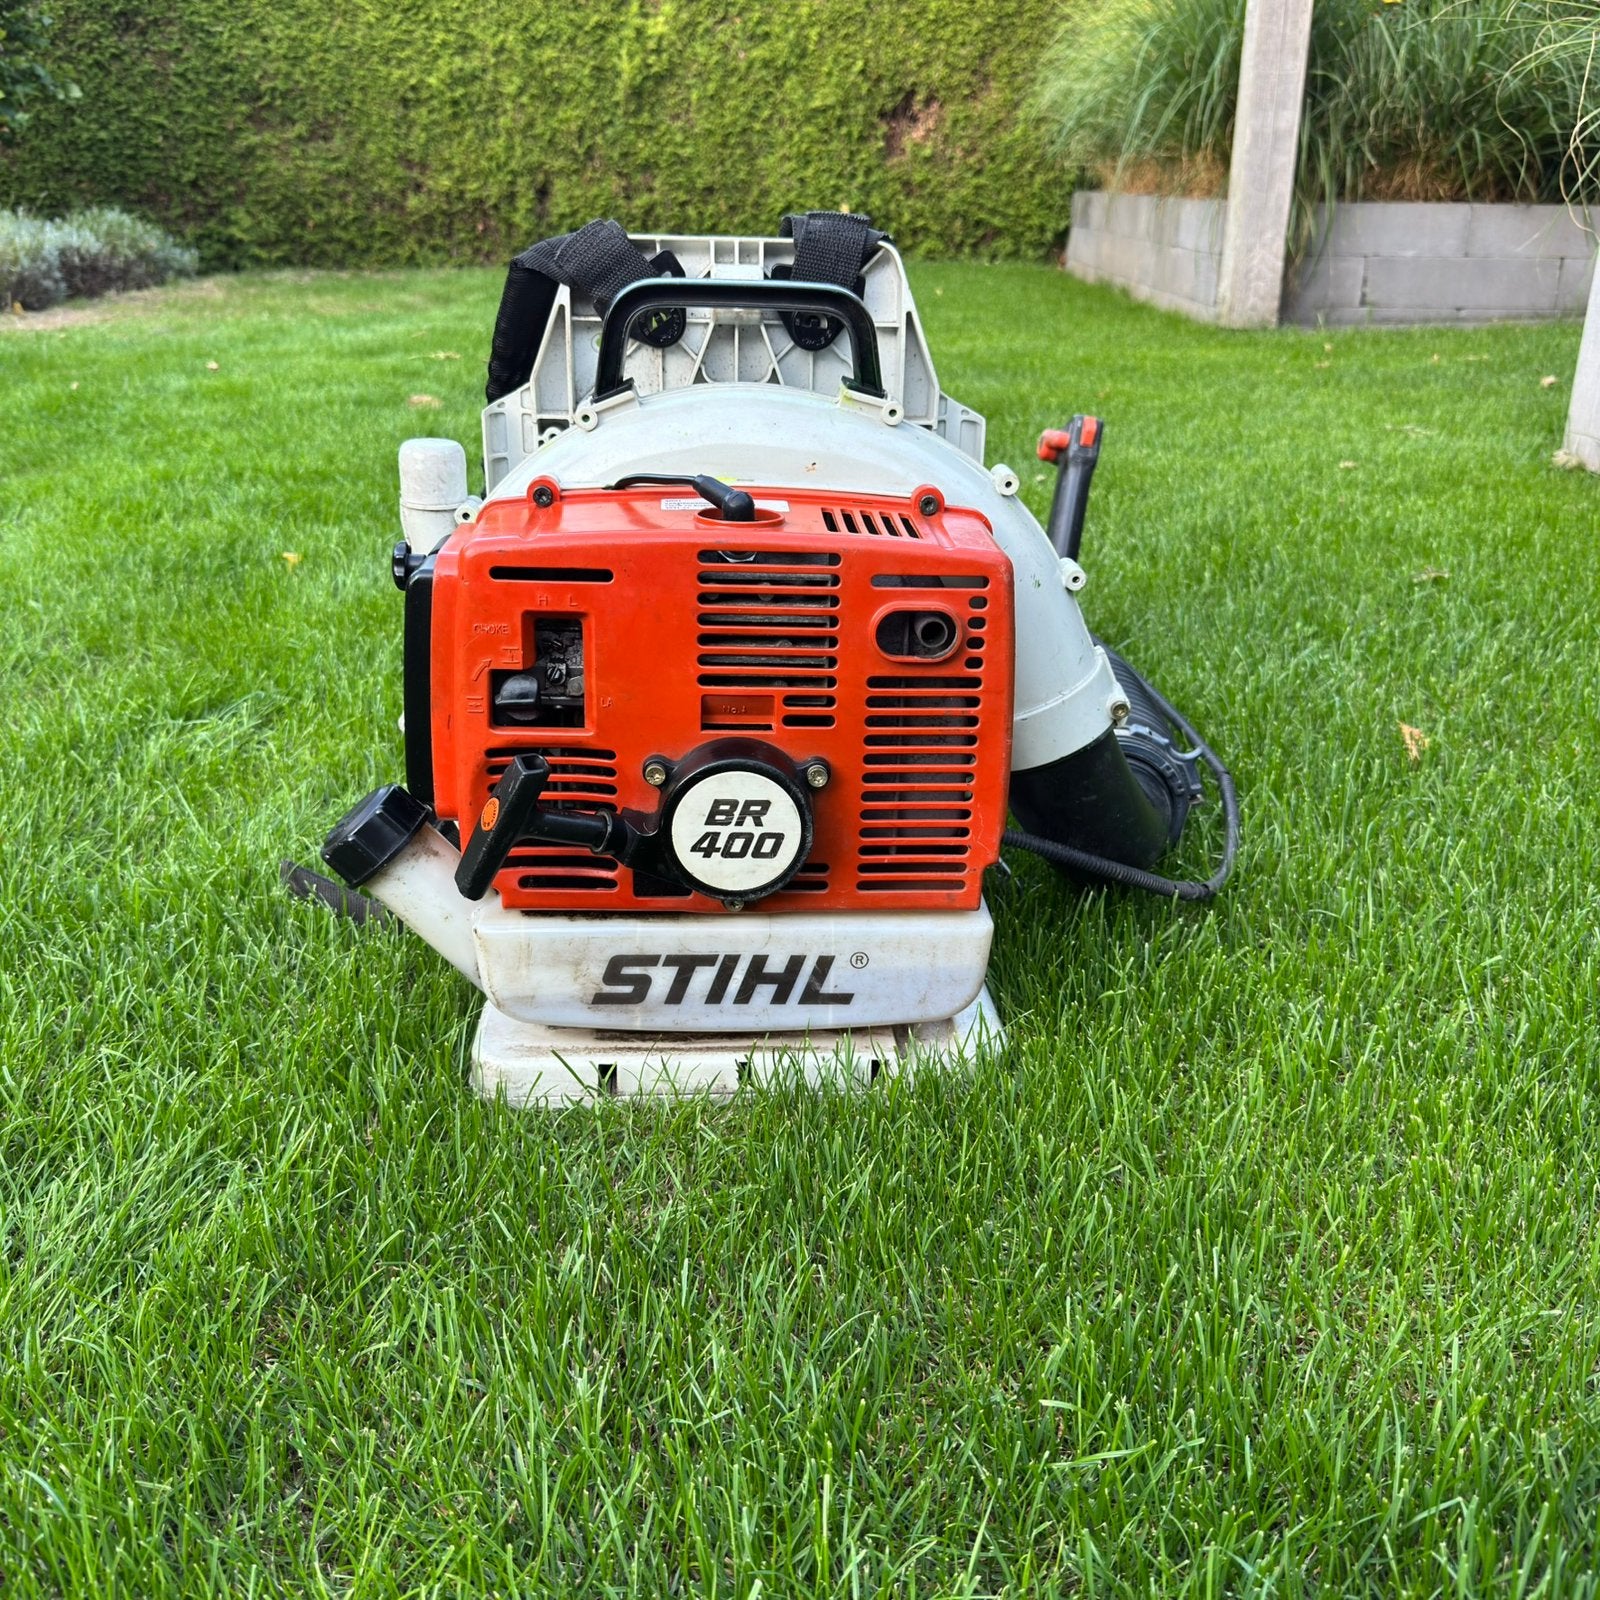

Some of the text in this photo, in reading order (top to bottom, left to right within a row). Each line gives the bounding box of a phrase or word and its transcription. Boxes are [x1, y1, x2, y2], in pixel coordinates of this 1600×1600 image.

[538, 595, 579, 607] H L
[473, 623, 510, 635] CHOKE
[704, 799, 772, 827] BR
[690, 831, 785, 859] 400
[591, 954, 855, 1005] STIHL
